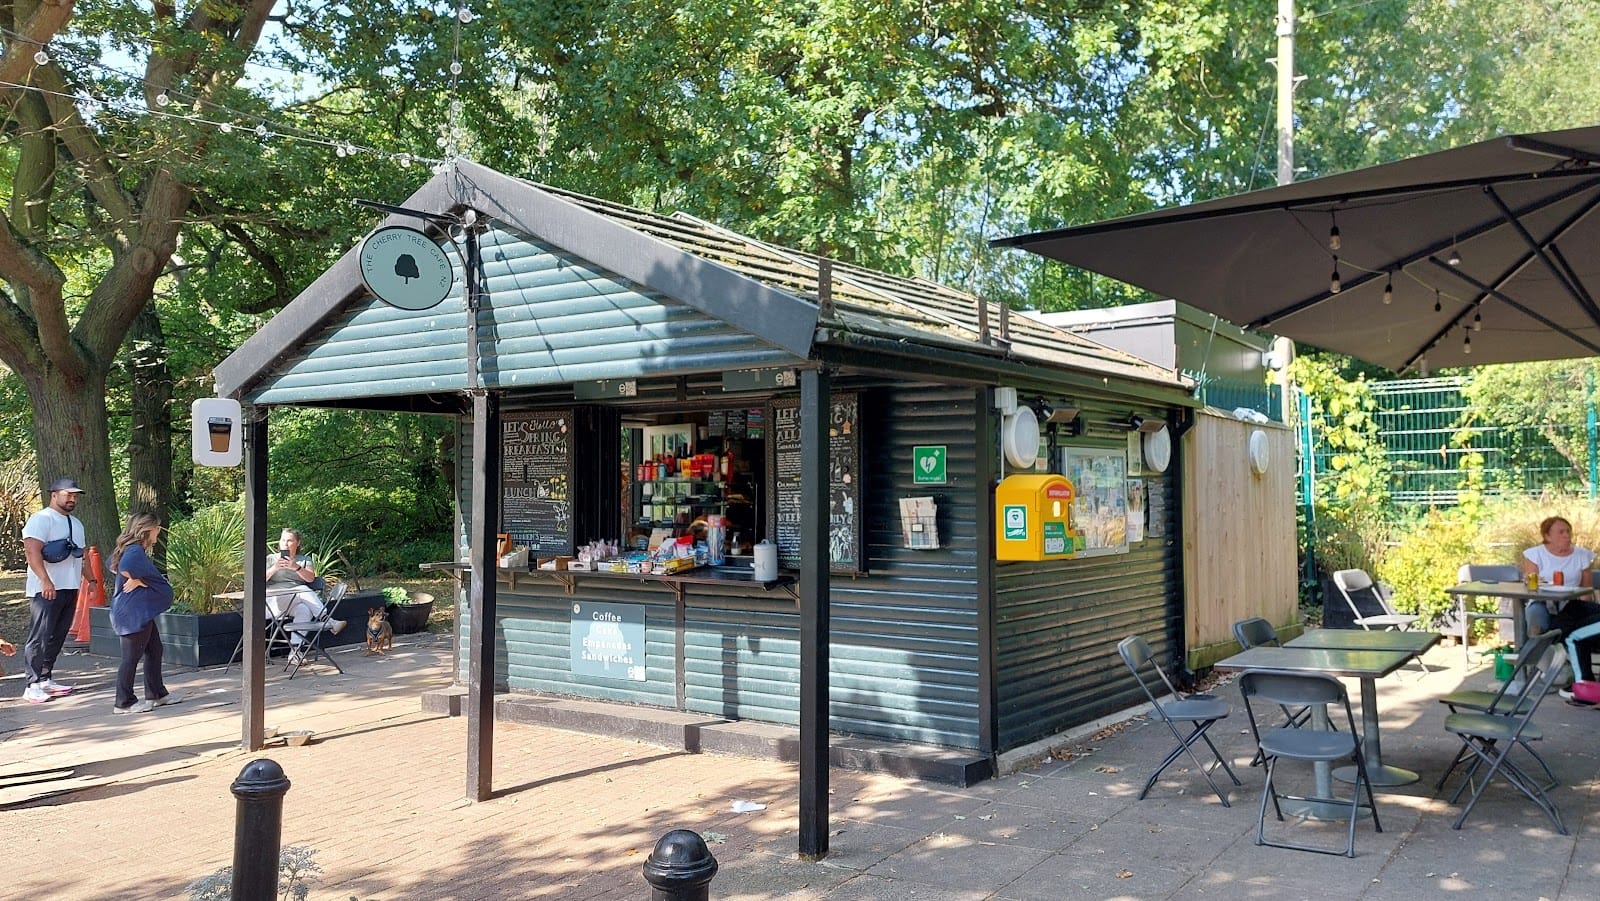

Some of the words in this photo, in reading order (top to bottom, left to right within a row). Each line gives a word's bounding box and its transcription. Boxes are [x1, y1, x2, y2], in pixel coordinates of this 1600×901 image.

[372, 233, 402, 250] CHERRY
[407, 234, 427, 249] TREE
[503, 444, 555, 455] BREAKFAST
[504, 487, 538, 497] LUNCH
[592, 611, 622, 622] Coffee
[581, 650, 633, 664] Sandwiches
